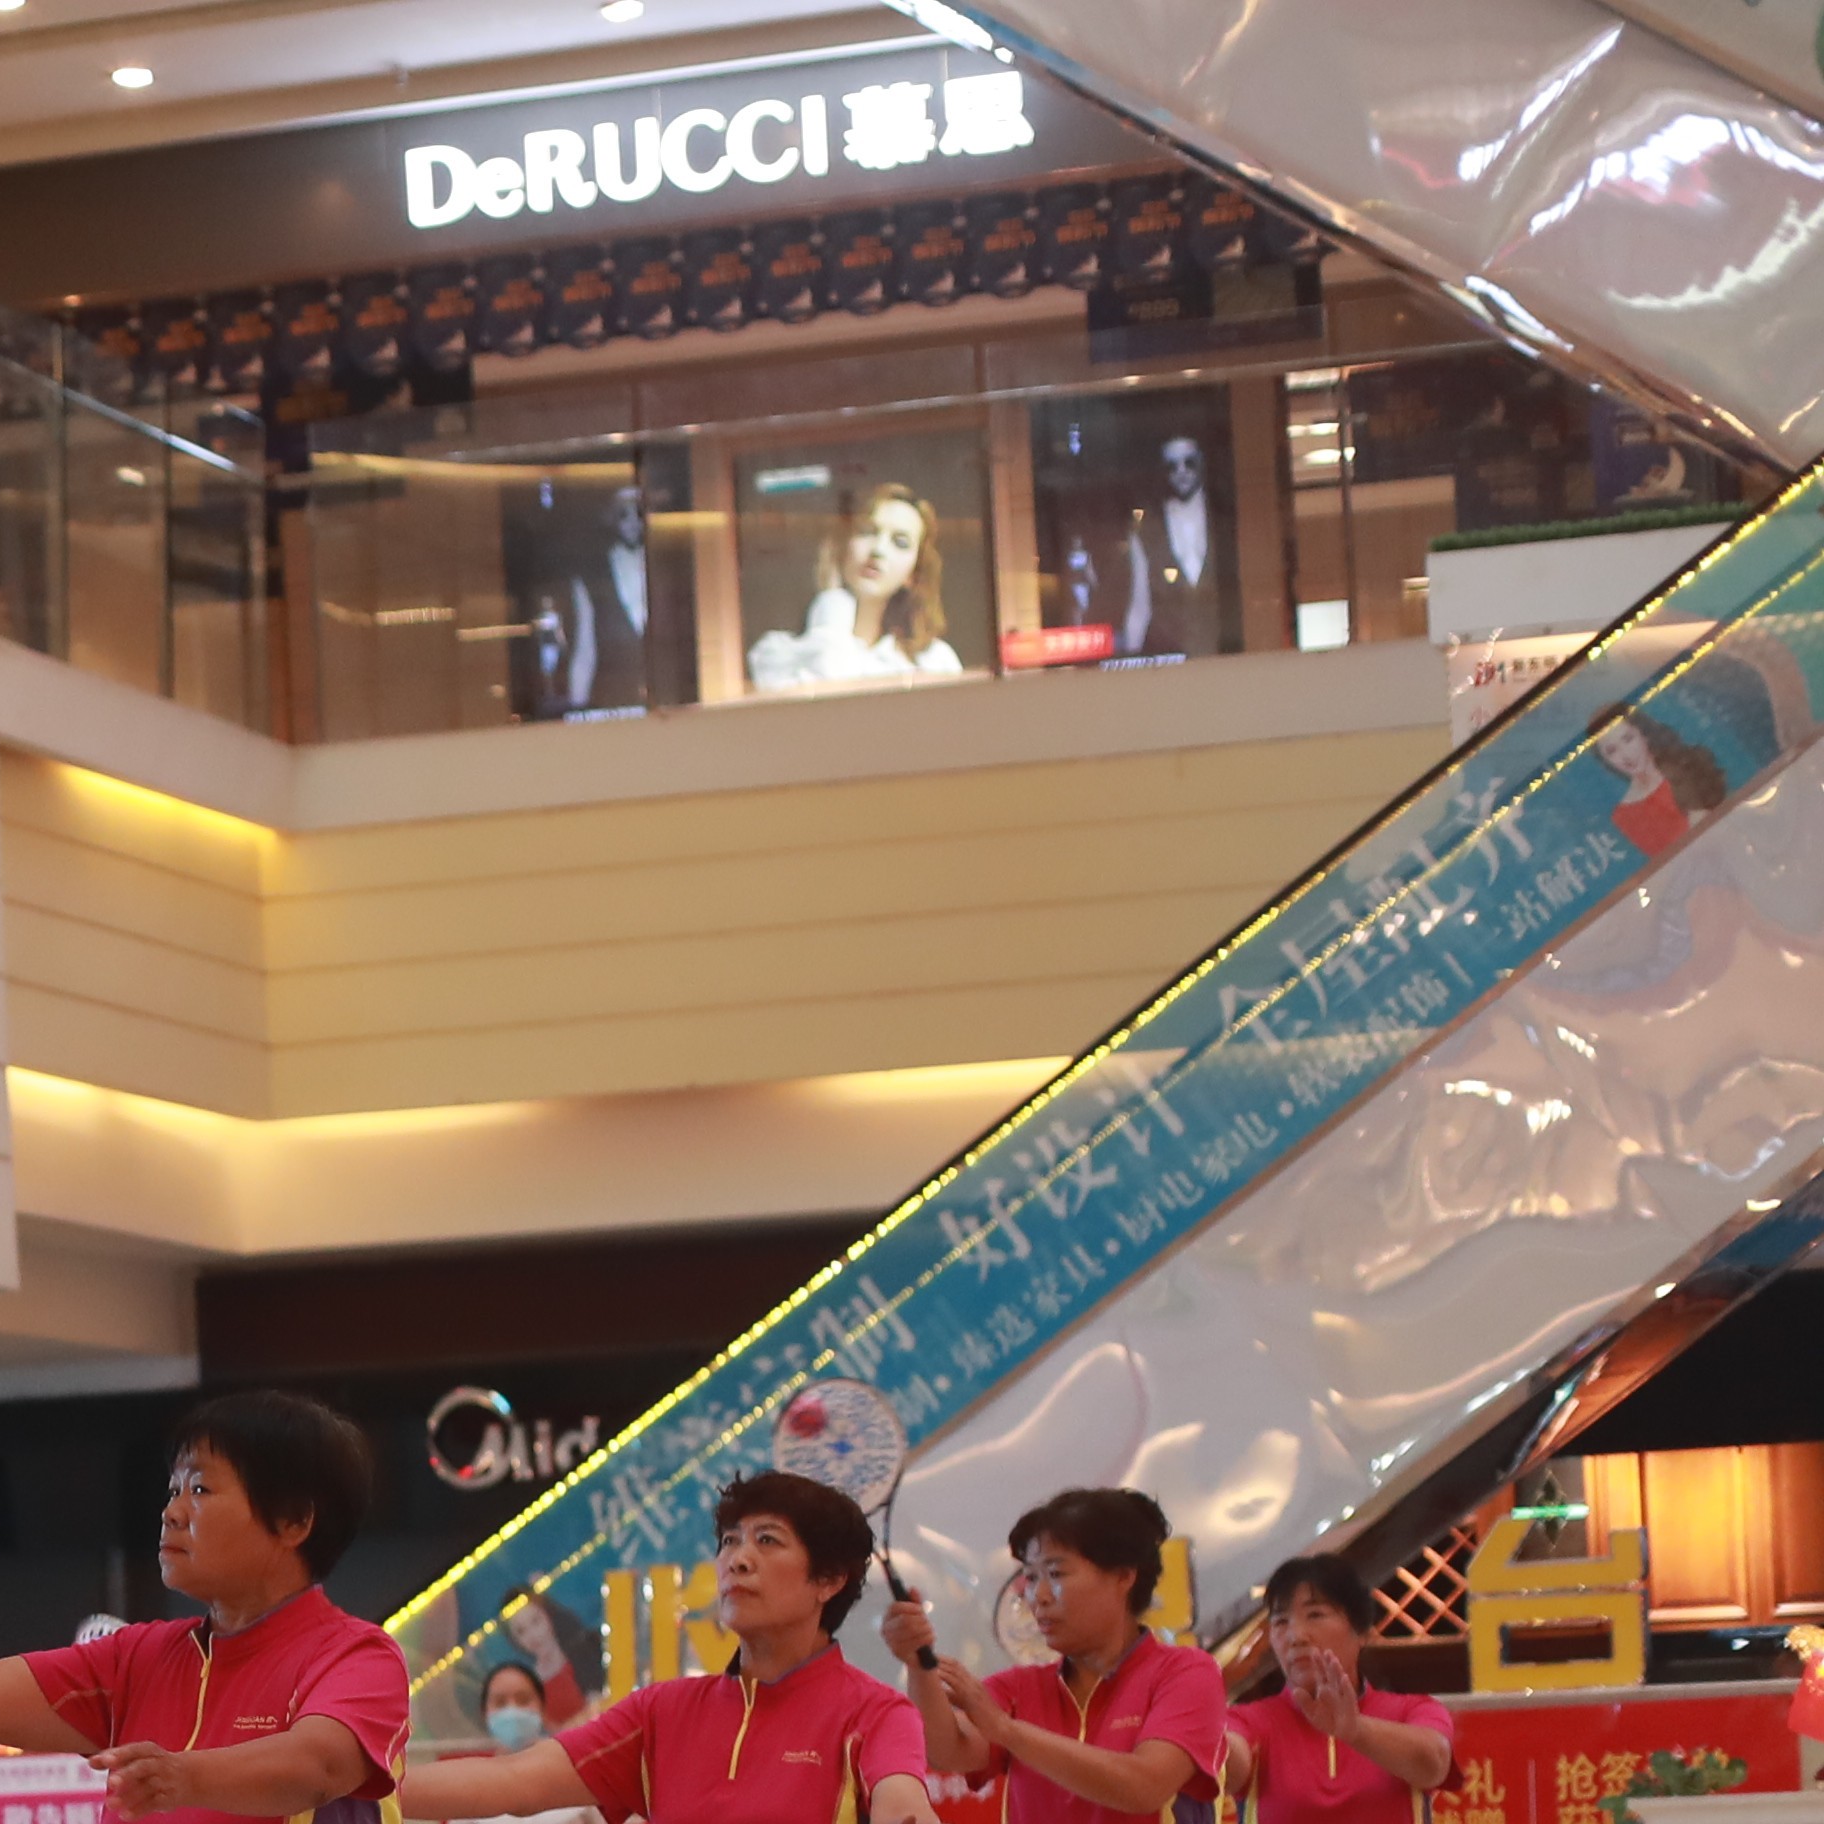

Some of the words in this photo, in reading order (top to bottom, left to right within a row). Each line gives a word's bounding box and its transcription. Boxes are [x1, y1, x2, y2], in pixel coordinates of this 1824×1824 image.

[405, 95, 828, 228] DeRUCCI
[939, 1061, 1185, 1284] 好设计
